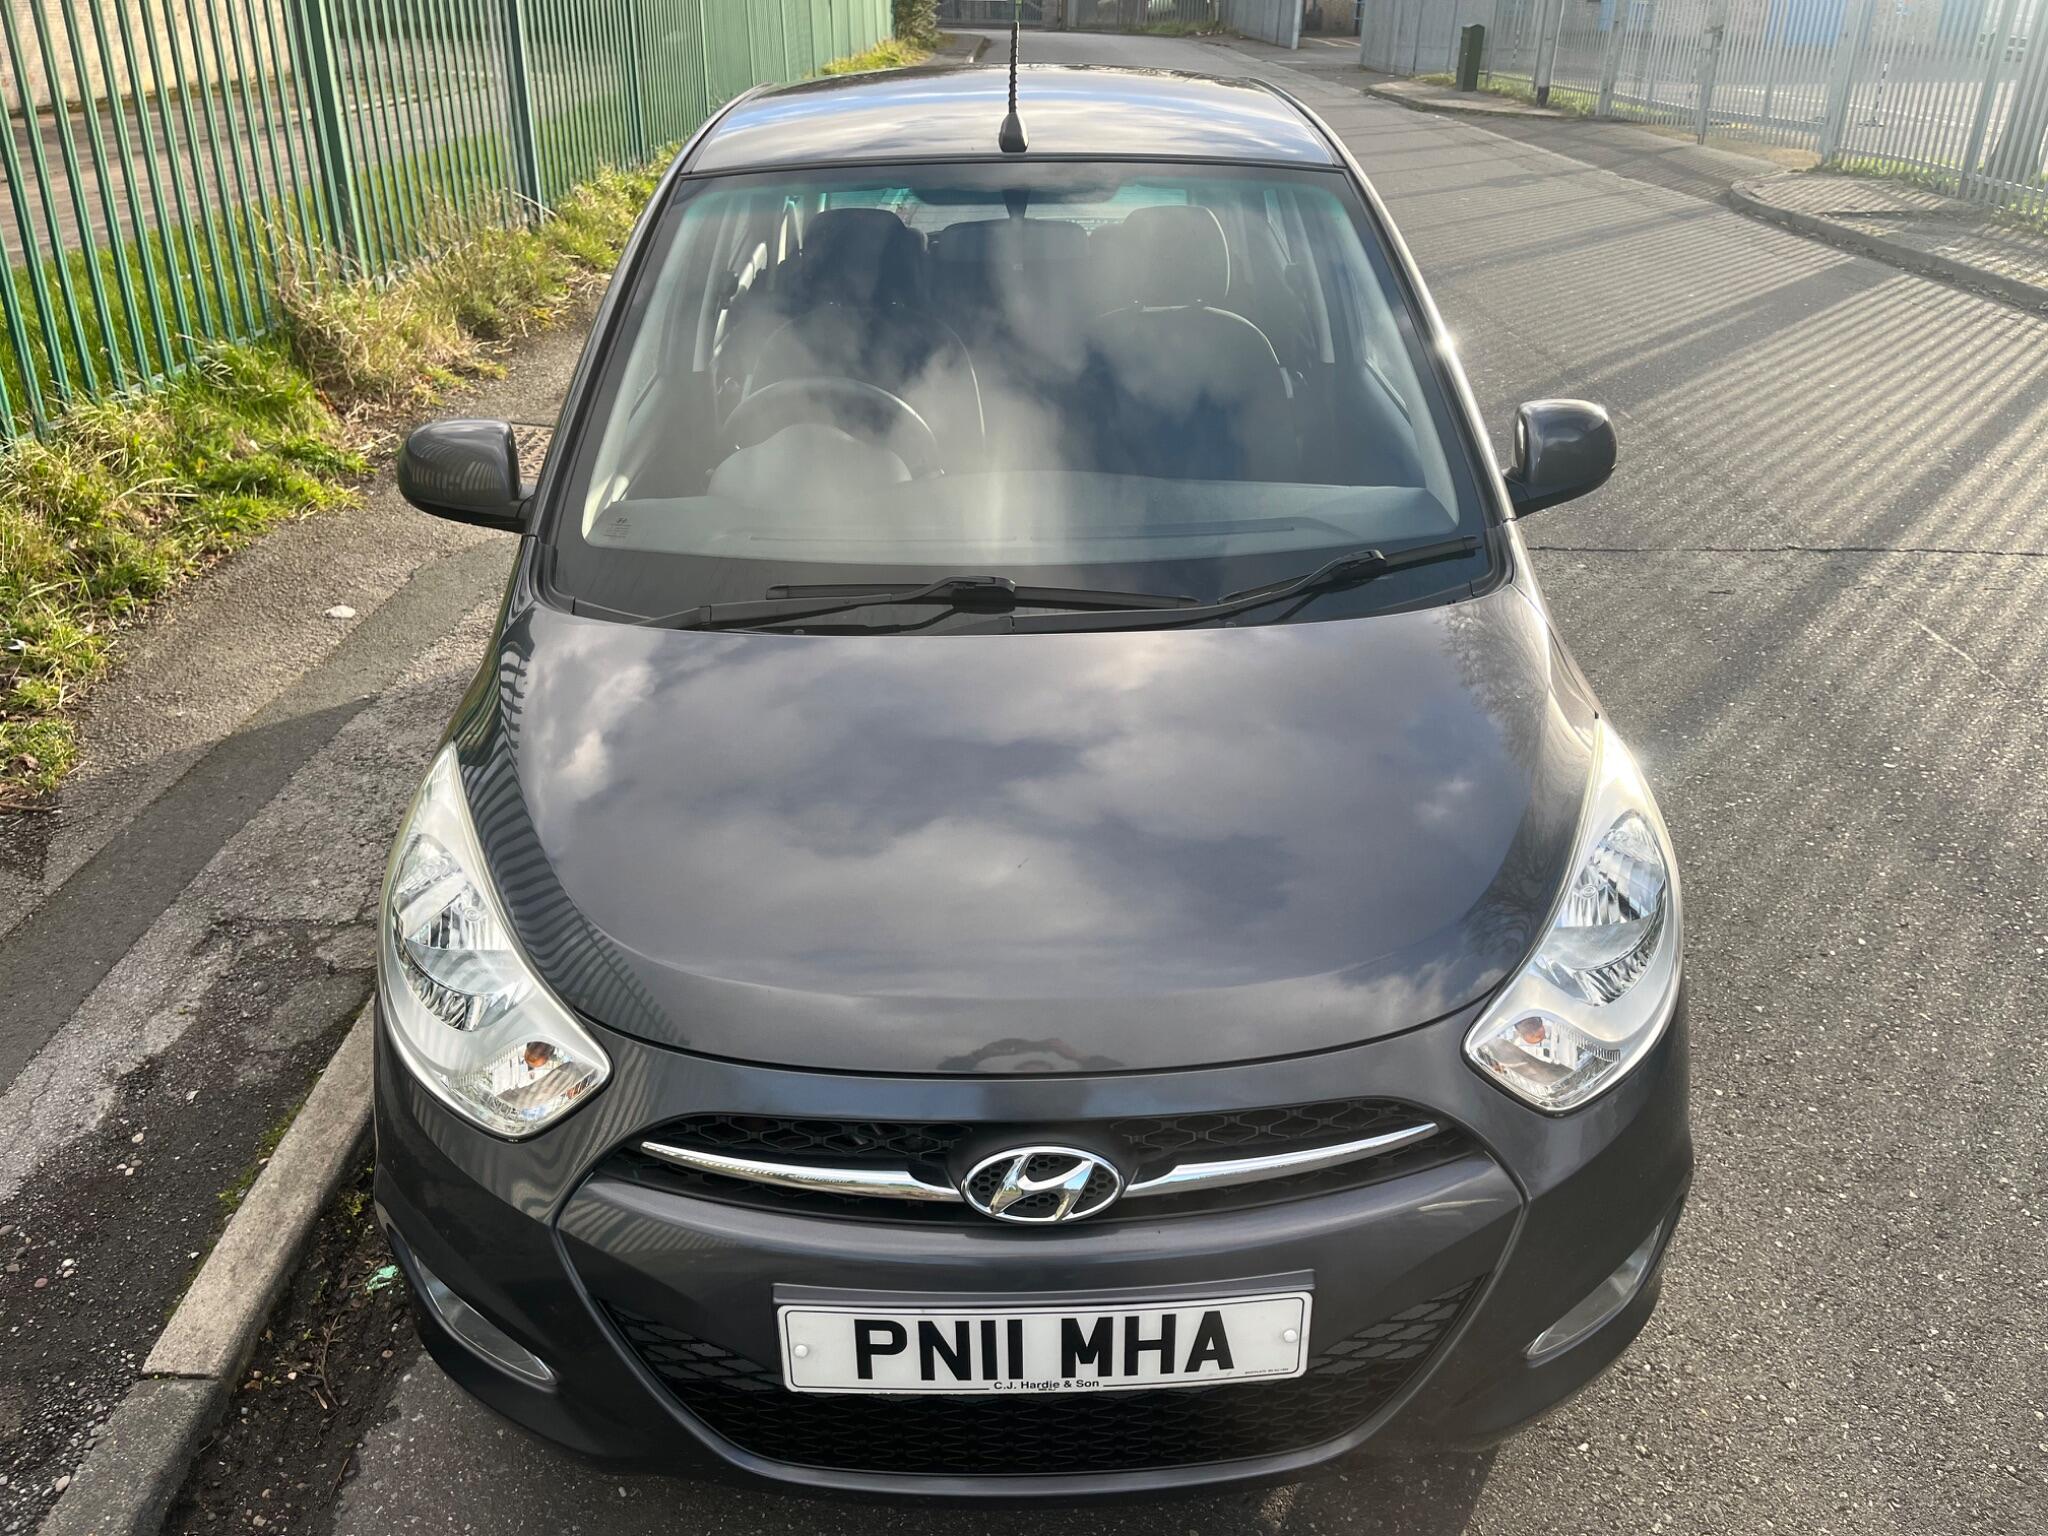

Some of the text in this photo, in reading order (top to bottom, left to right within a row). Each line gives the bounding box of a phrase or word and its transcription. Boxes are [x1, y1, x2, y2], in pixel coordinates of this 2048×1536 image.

[853, 1310, 1235, 1382] PN11 MHA
[993, 1381, 1017, 1390] C.J.
[1020, 1380, 1060, 1390] Hardie
[1063, 1379, 1072, 1388] &
[1076, 1379, 1100, 1388] Son
